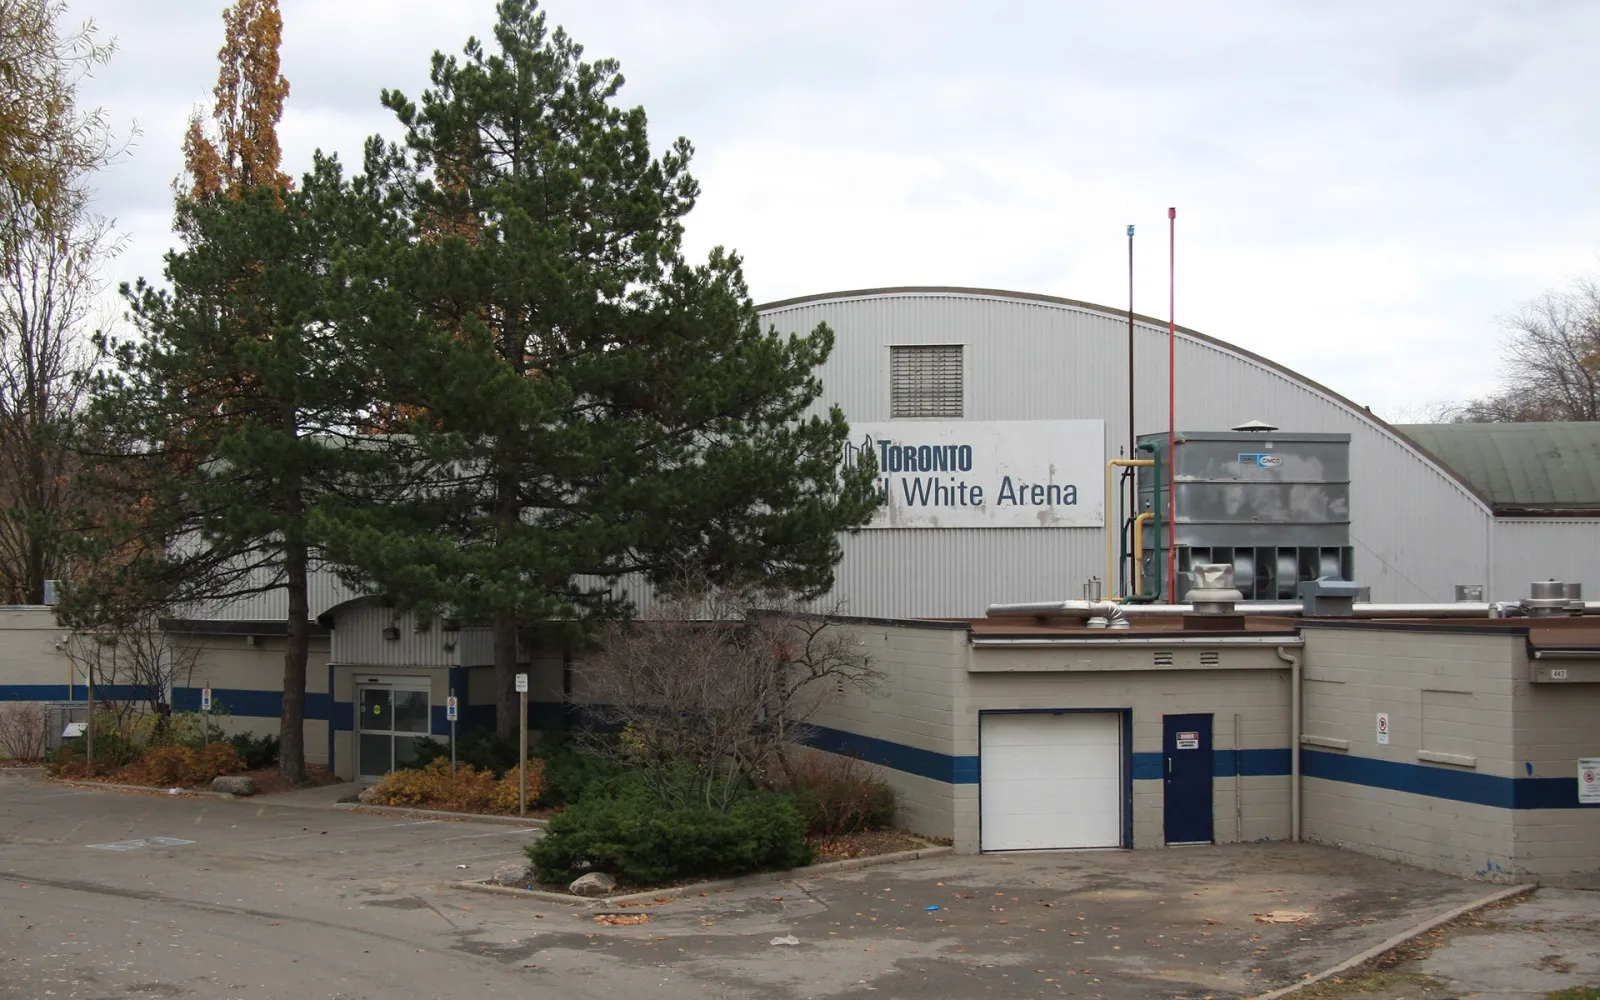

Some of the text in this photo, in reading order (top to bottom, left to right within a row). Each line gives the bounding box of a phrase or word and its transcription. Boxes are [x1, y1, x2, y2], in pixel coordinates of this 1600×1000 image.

[877, 440, 972, 472] TORONTO
[902, 477, 983, 506] White
[996, 475, 1078, 506] Arena
